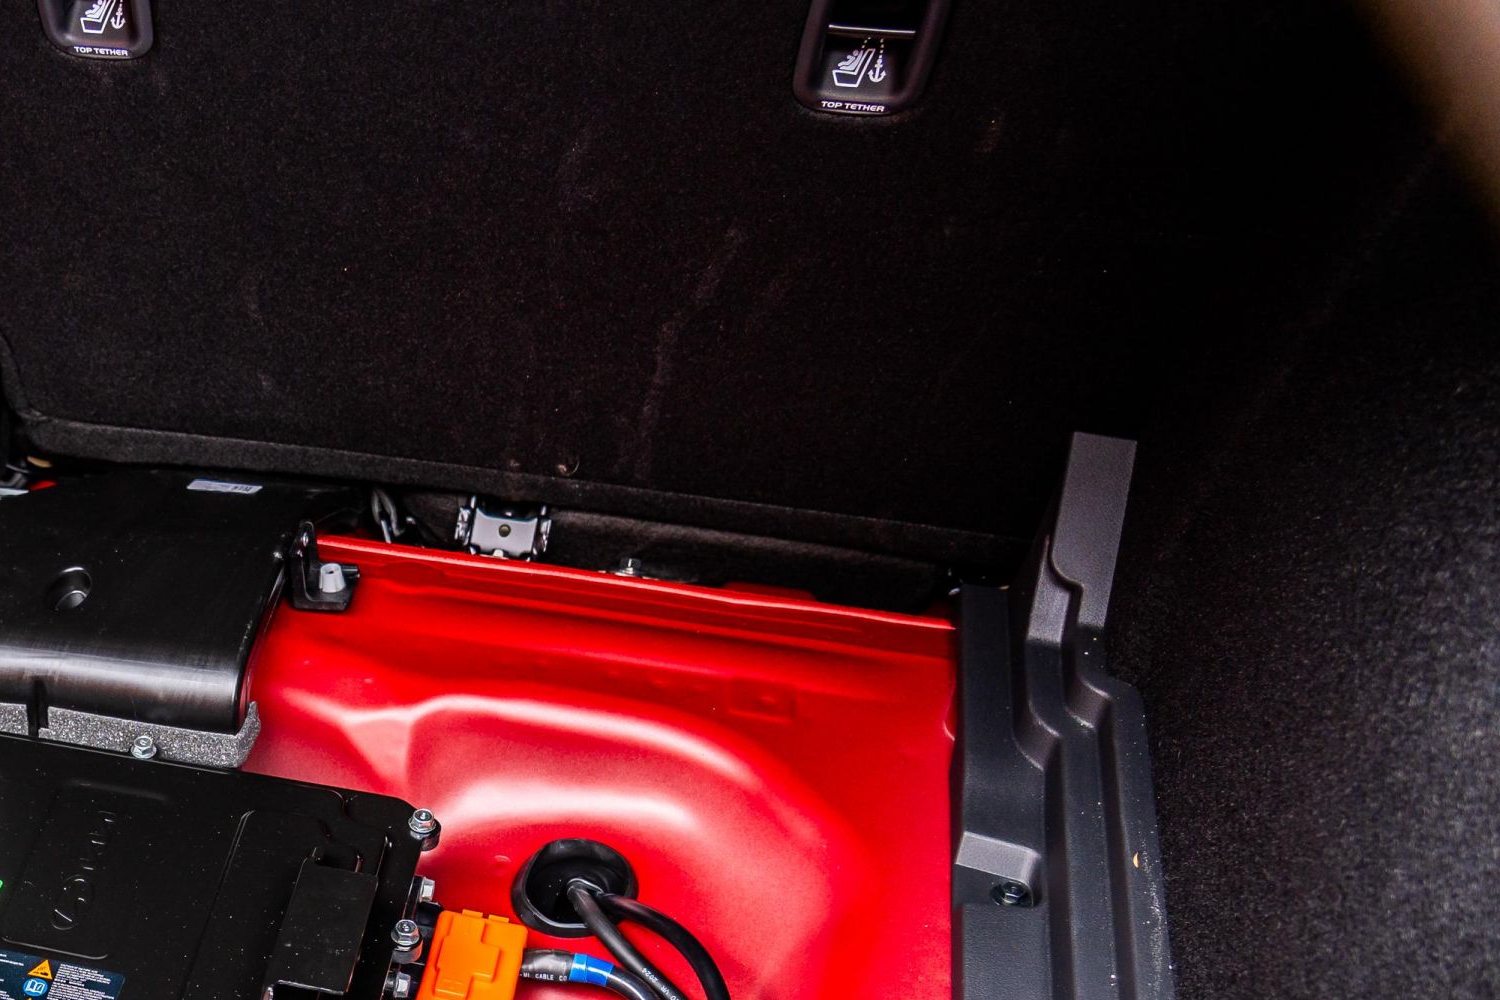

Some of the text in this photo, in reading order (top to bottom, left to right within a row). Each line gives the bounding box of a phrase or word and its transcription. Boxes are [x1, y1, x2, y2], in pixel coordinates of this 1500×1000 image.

[94, 47, 128, 56] TETHER
[821, 101, 885, 112] TOP TETHER
[642, 968, 658, 983] 2024
